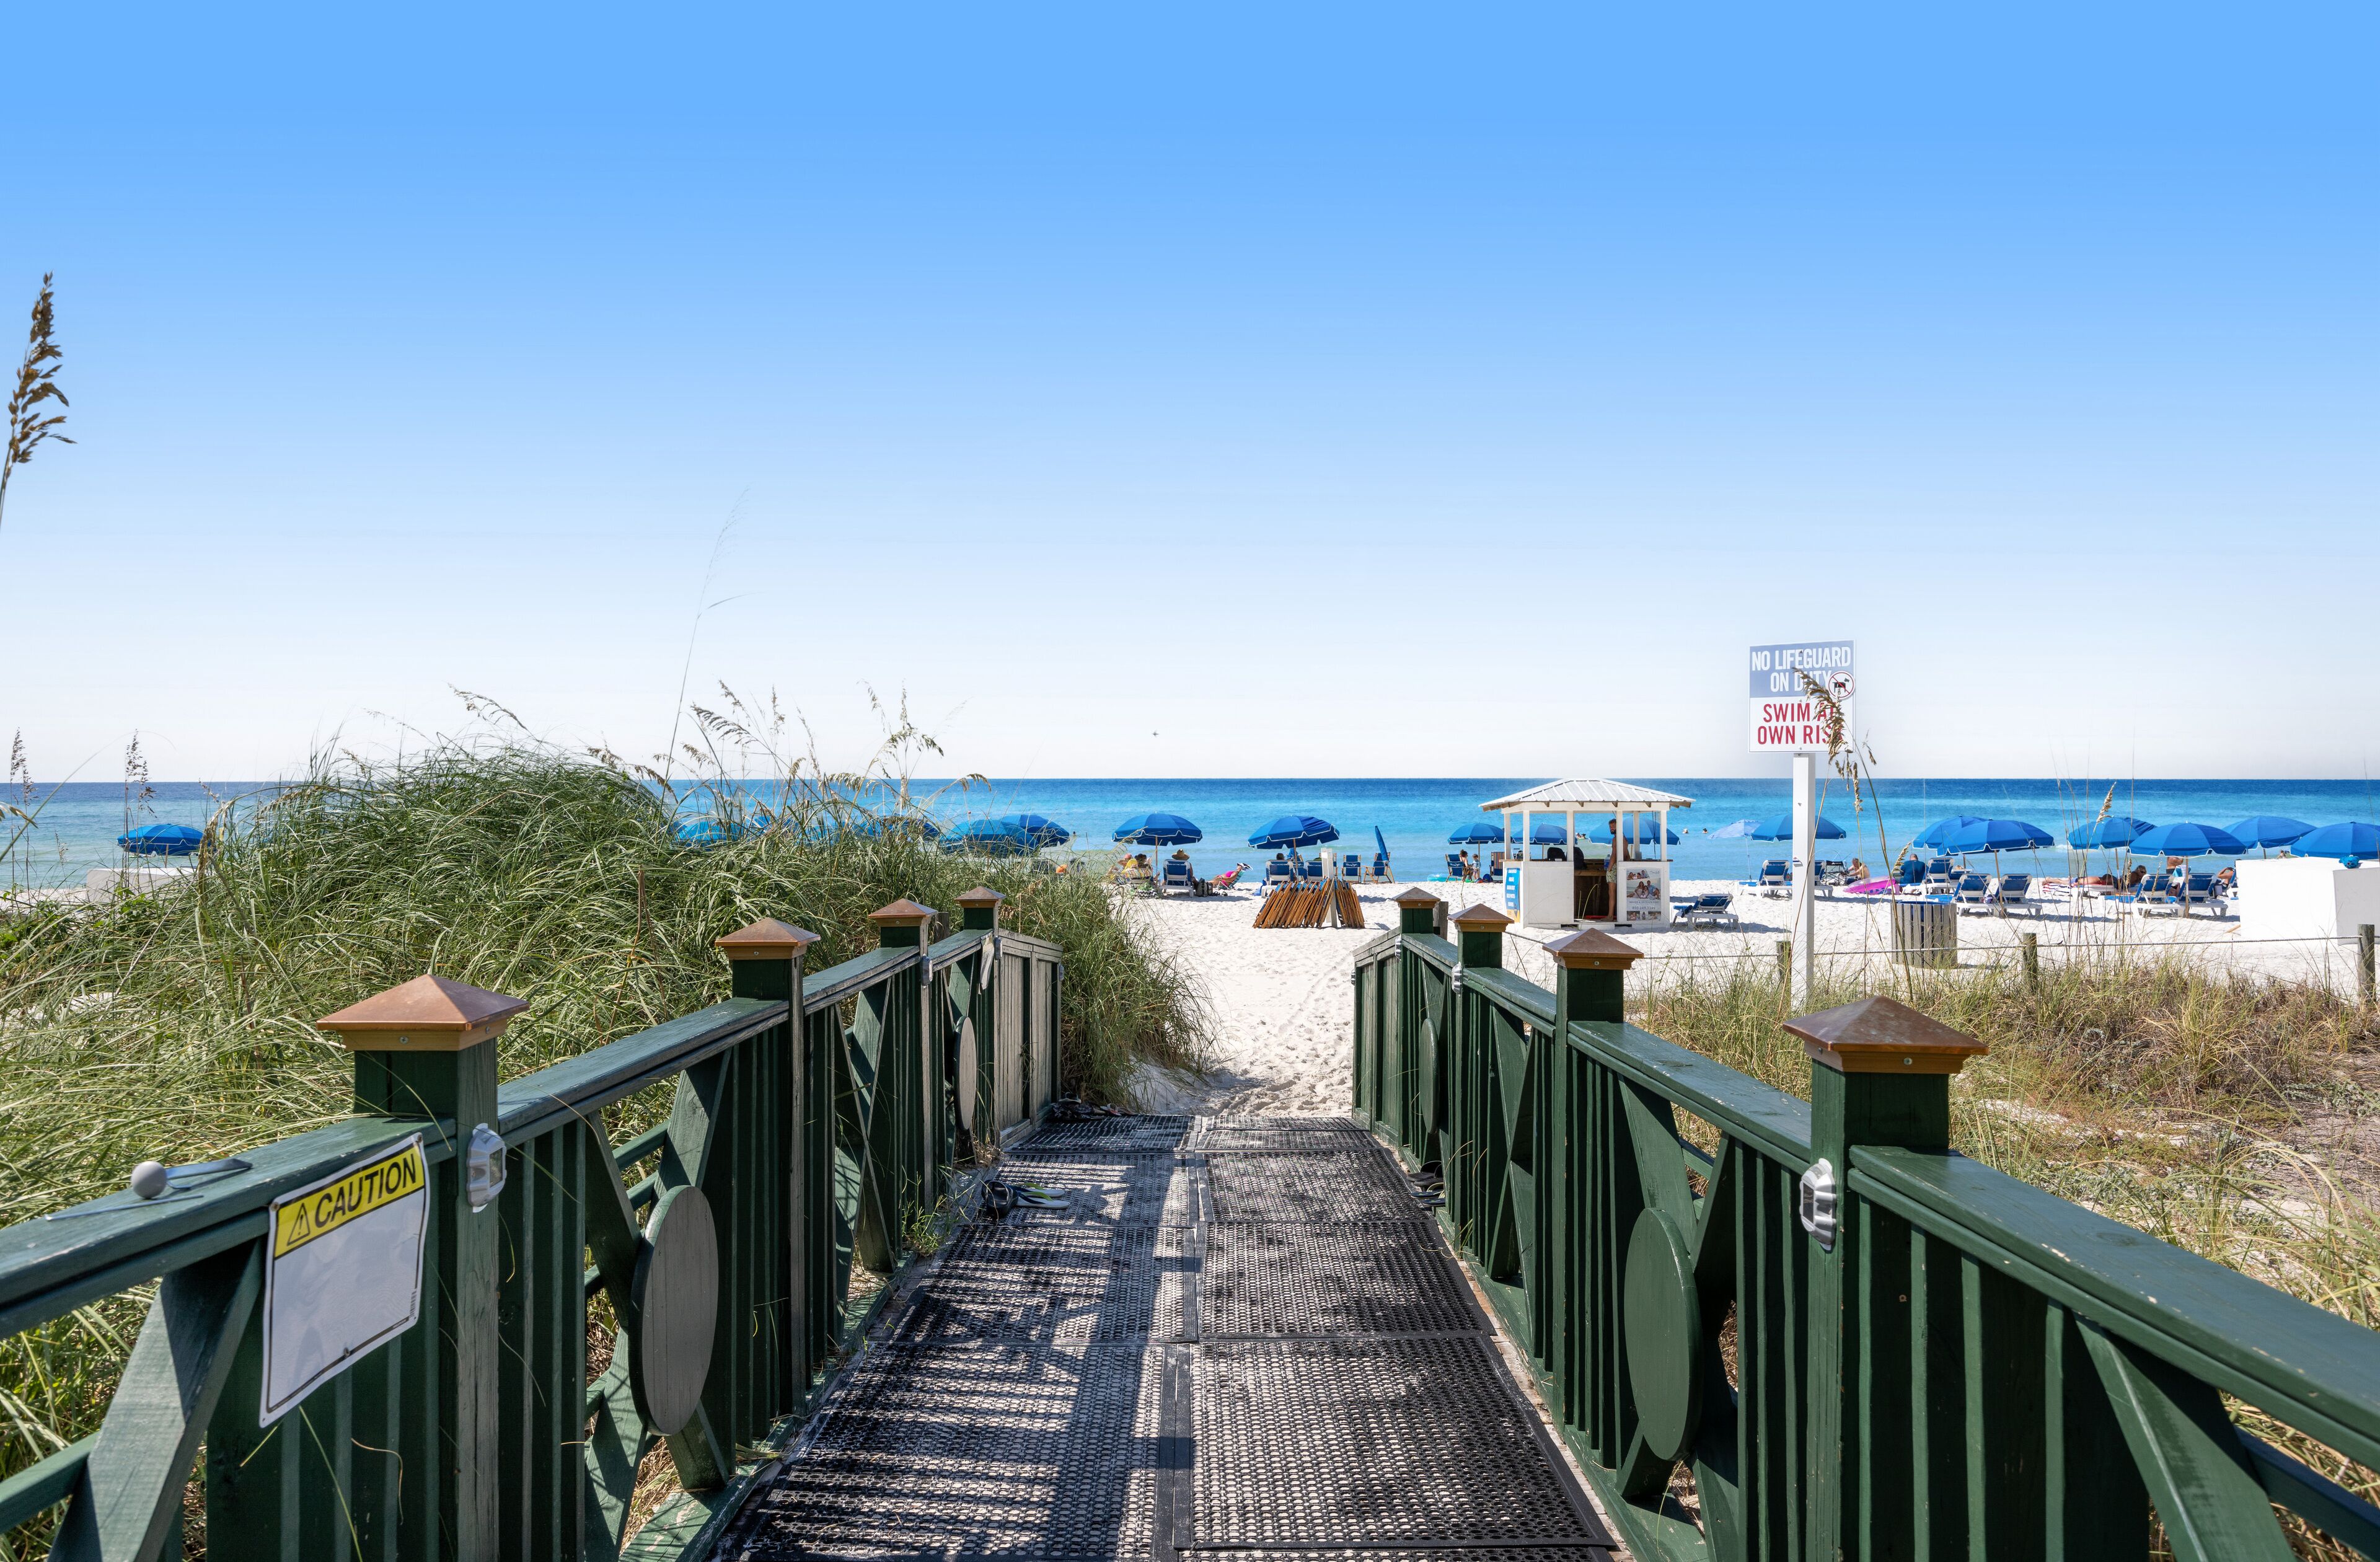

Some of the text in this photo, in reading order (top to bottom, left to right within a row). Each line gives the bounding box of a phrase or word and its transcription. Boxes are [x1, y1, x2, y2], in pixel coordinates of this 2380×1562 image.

[1752, 646, 1851, 671] NO LIFEGUARD
[1770, 672, 1789, 692] ON
[1763, 702, 1810, 723] SWIM
[1758, 725, 1843, 745] OWN RIS
[315, 1154, 416, 1228] CAUTION
